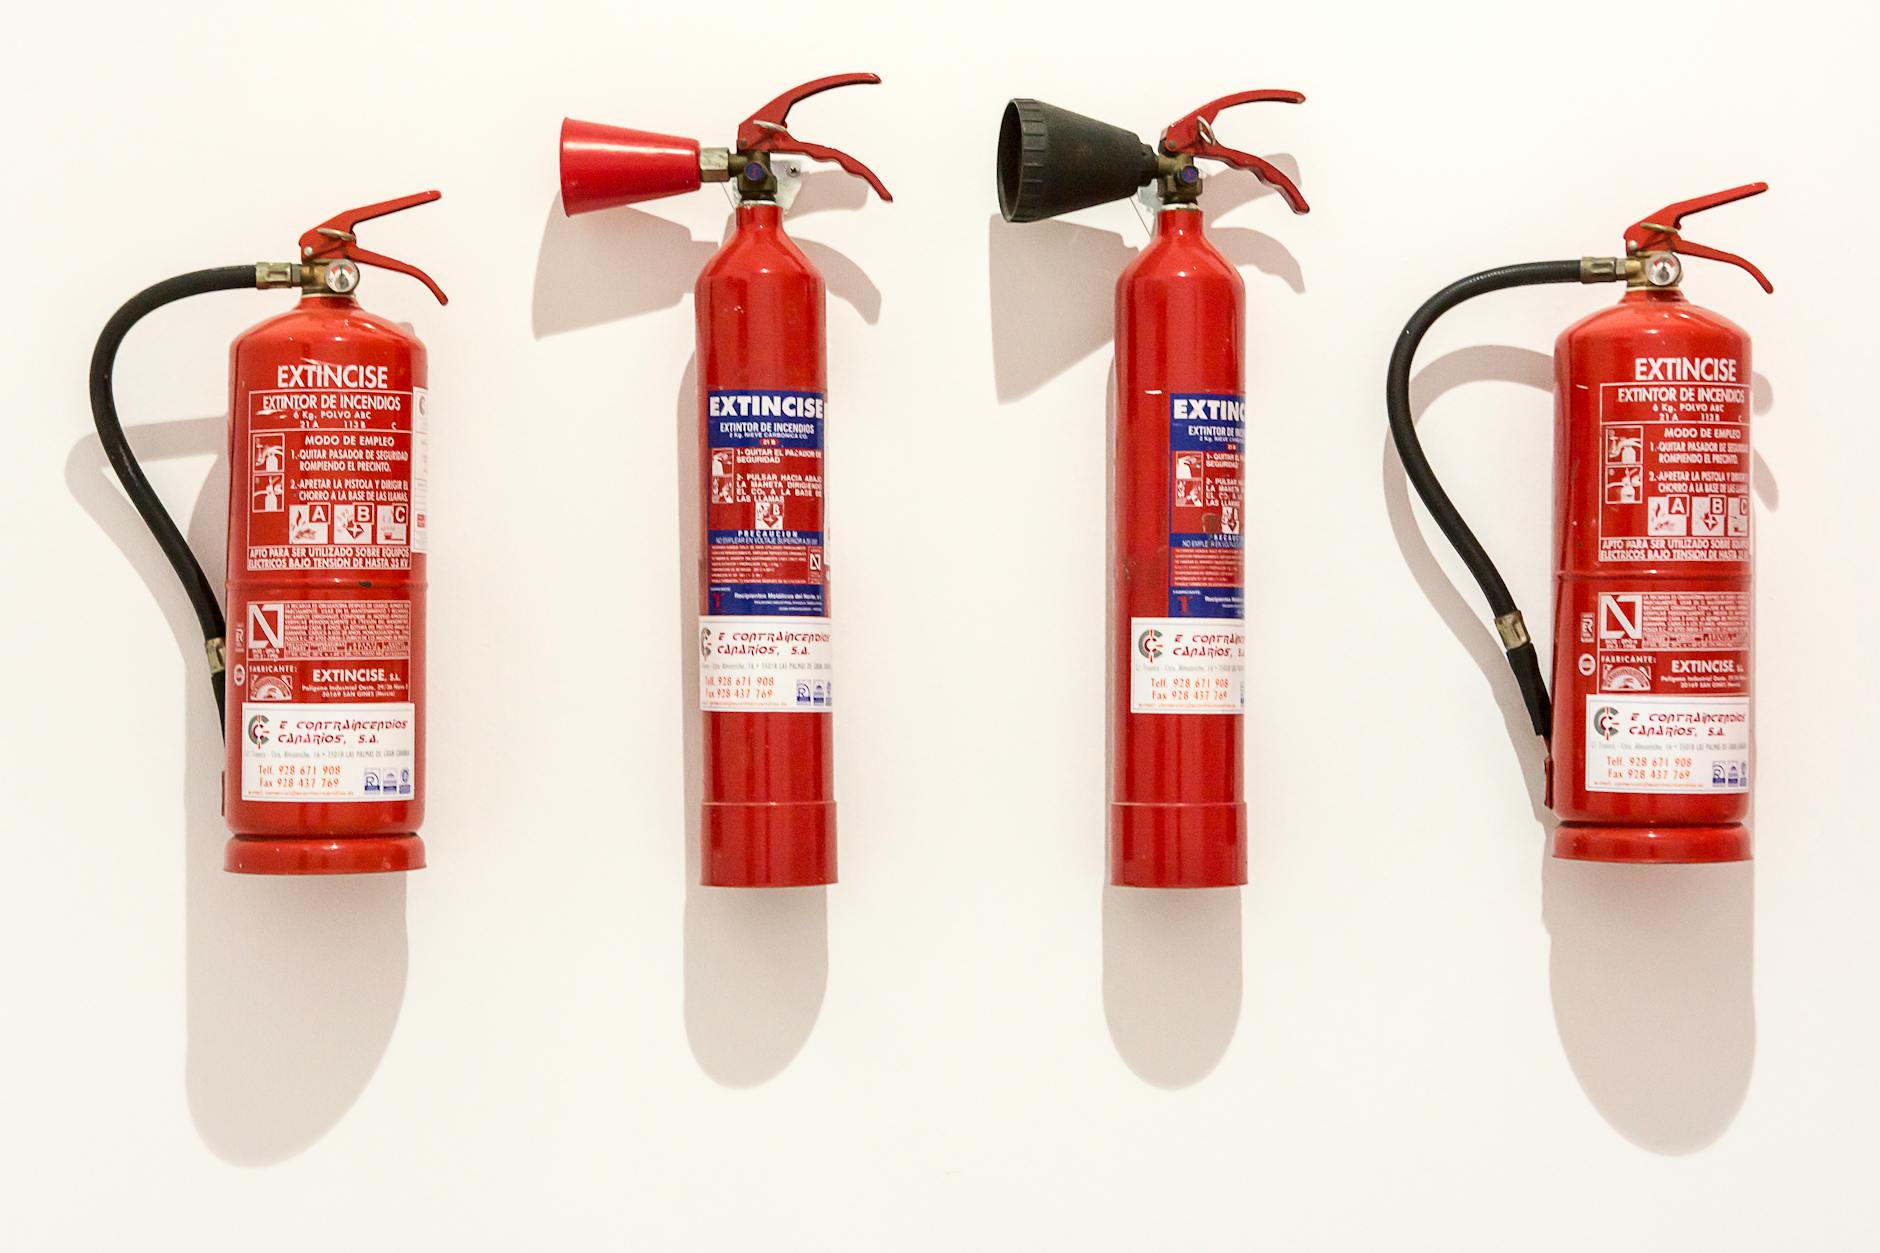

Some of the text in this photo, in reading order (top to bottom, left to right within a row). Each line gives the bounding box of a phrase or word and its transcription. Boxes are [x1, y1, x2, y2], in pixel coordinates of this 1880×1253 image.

[1635, 358, 1736, 381] EXTINCISE
[278, 365, 388, 388] EXTINCISE
[1618, 388, 1744, 403] EXTINTOR DE INCENDIOS
[263, 395, 400, 410] EXTINTOR DE INCENDIOS
[710, 396, 823, 418] EXTINCISE
[1653, 404, 1658, 412] 6
[1680, 404, 1708, 412] POLVO
[1710, 404, 1724, 412] ABC
[294, 411, 299, 420] 6
[321, 411, 351, 420] POLVO
[354, 411, 371, 420] ABC
[720, 422, 814, 434] EXTINTOR DE INCENDIOS
[1189, 426, 1225, 436] EXTINTOR
[1227, 427, 1234, 436] DE
[1664, 428, 1740, 439] MODO DE EMPLEO
[305, 436, 394, 446] MODO DE EMPLEO
[1687, 442, 1718, 452] PASADOR
[329, 450, 408, 461] PASADOR DE SEGURIDAD
[736, 456, 780, 464] SEGURIDAD
[1659, 453, 1711, 464] ROMPIENDO EL
[300, 461, 391, 472] ROMPIENDO EL PRECINTO.
[1691, 471, 1699, 481] LA
[1702, 471, 1724, 481] PISTOLA
[333, 479, 342, 489] LA
[345, 479, 373, 489] PISTOLA
[375, 479, 379, 489] Y
[1658, 483, 1687, 493] CHORRO
[1689, 483, 1694, 493] A
[1696, 483, 1704, 493] LA
[299, 491, 386, 501] CHORRO A LA BASE DE LAS
[1671, 498, 1747, 513] A B C
[312, 506, 405, 521] A B C
[1602, 540, 1623, 549] APTO
[1626, 540, 1648, 549] PARA
[1651, 540, 1665, 549] SER
[1669, 540, 1708, 549] UTILIZADO
[250, 548, 409, 557] APTO PARA SER UTILIZADO SOBRE EQUIPOS
[1648, 550, 1670, 560] BAJO
[1674, 550, 1706, 560] TENSION
[249, 558, 388, 568] ELECTRICOS BAJO TENSION DE HASTA
[719, 677, 774, 686] 928 671 908
[1173, 678, 1190, 688] 928
[1195, 678, 1210, 688] 671
[717, 689, 772, 698] 928 437 769
[1172, 691, 1188, 700] 928
[1629, 757, 1692, 767] 928 671 908
[278, 765, 341, 774] 928 671 908
[1608, 770, 1622, 778] Fax
[1628, 770, 1645, 780] 928
[1673, 770, 1690, 780] 769
[260, 779, 272, 787] Fax
[277, 779, 293, 787] 928
[322, 779, 339, 787] 769
